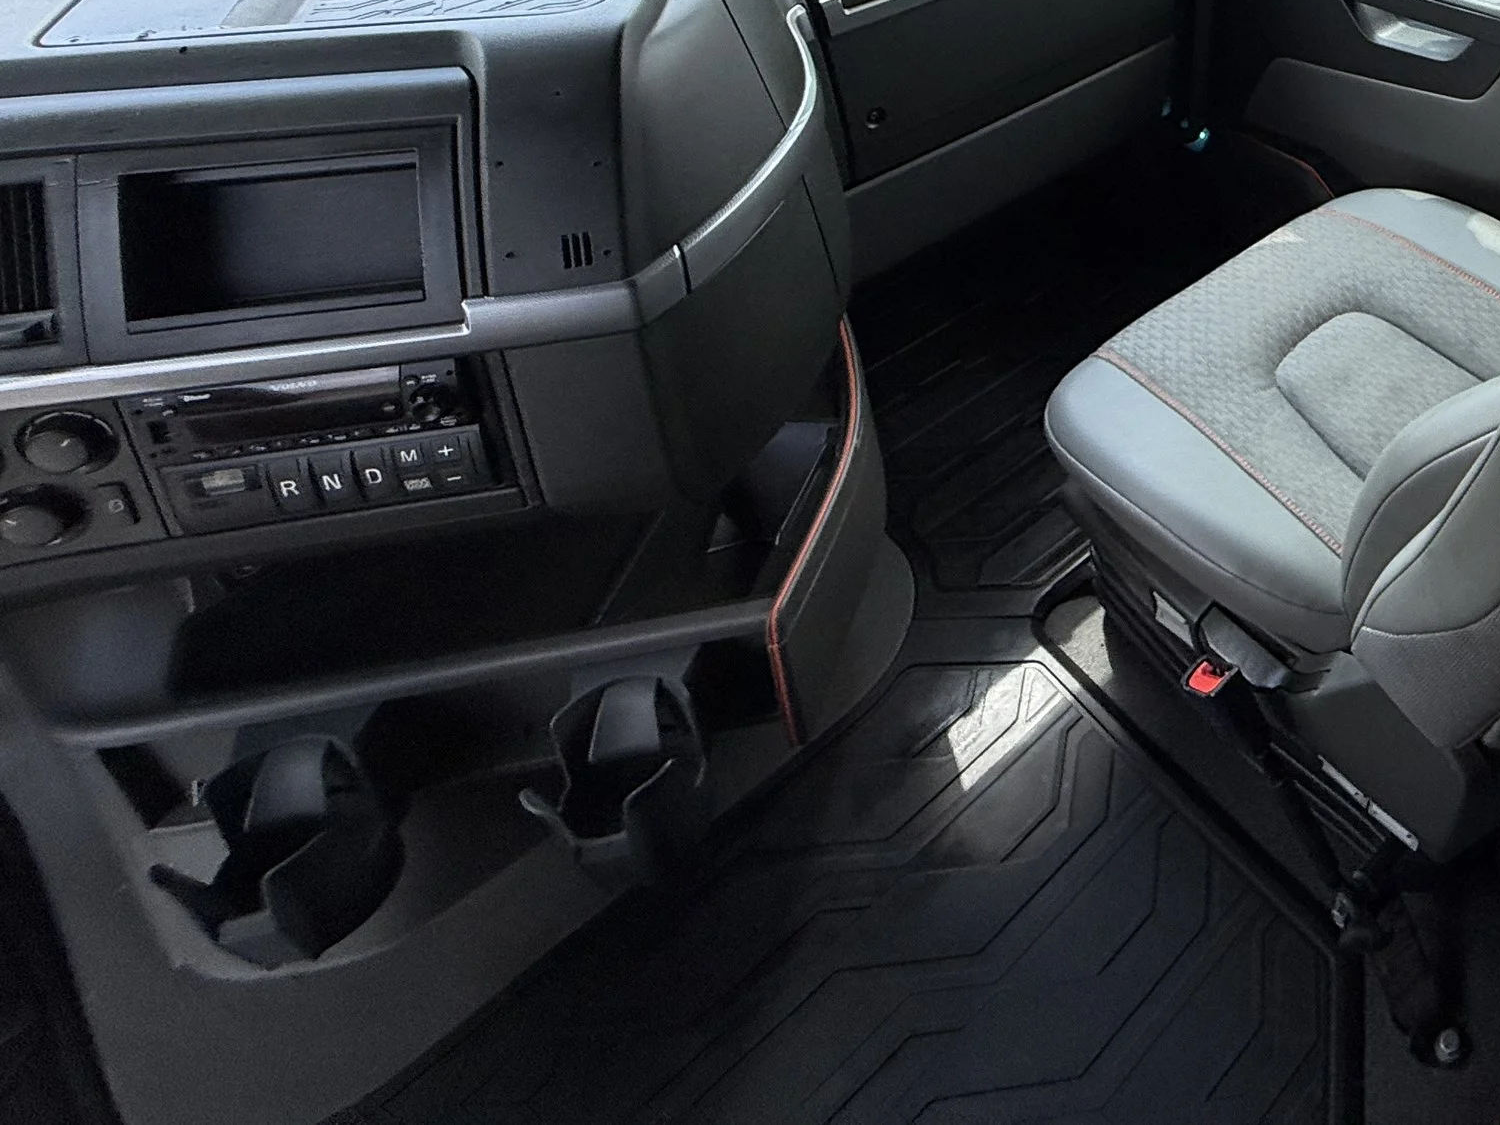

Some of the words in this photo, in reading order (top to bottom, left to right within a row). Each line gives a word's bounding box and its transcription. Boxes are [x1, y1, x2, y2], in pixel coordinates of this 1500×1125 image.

[280, 480, 300, 497] R
[322, 473, 342, 491] N
[365, 468, 383, 484] D
[400, 449, 418, 463] M
